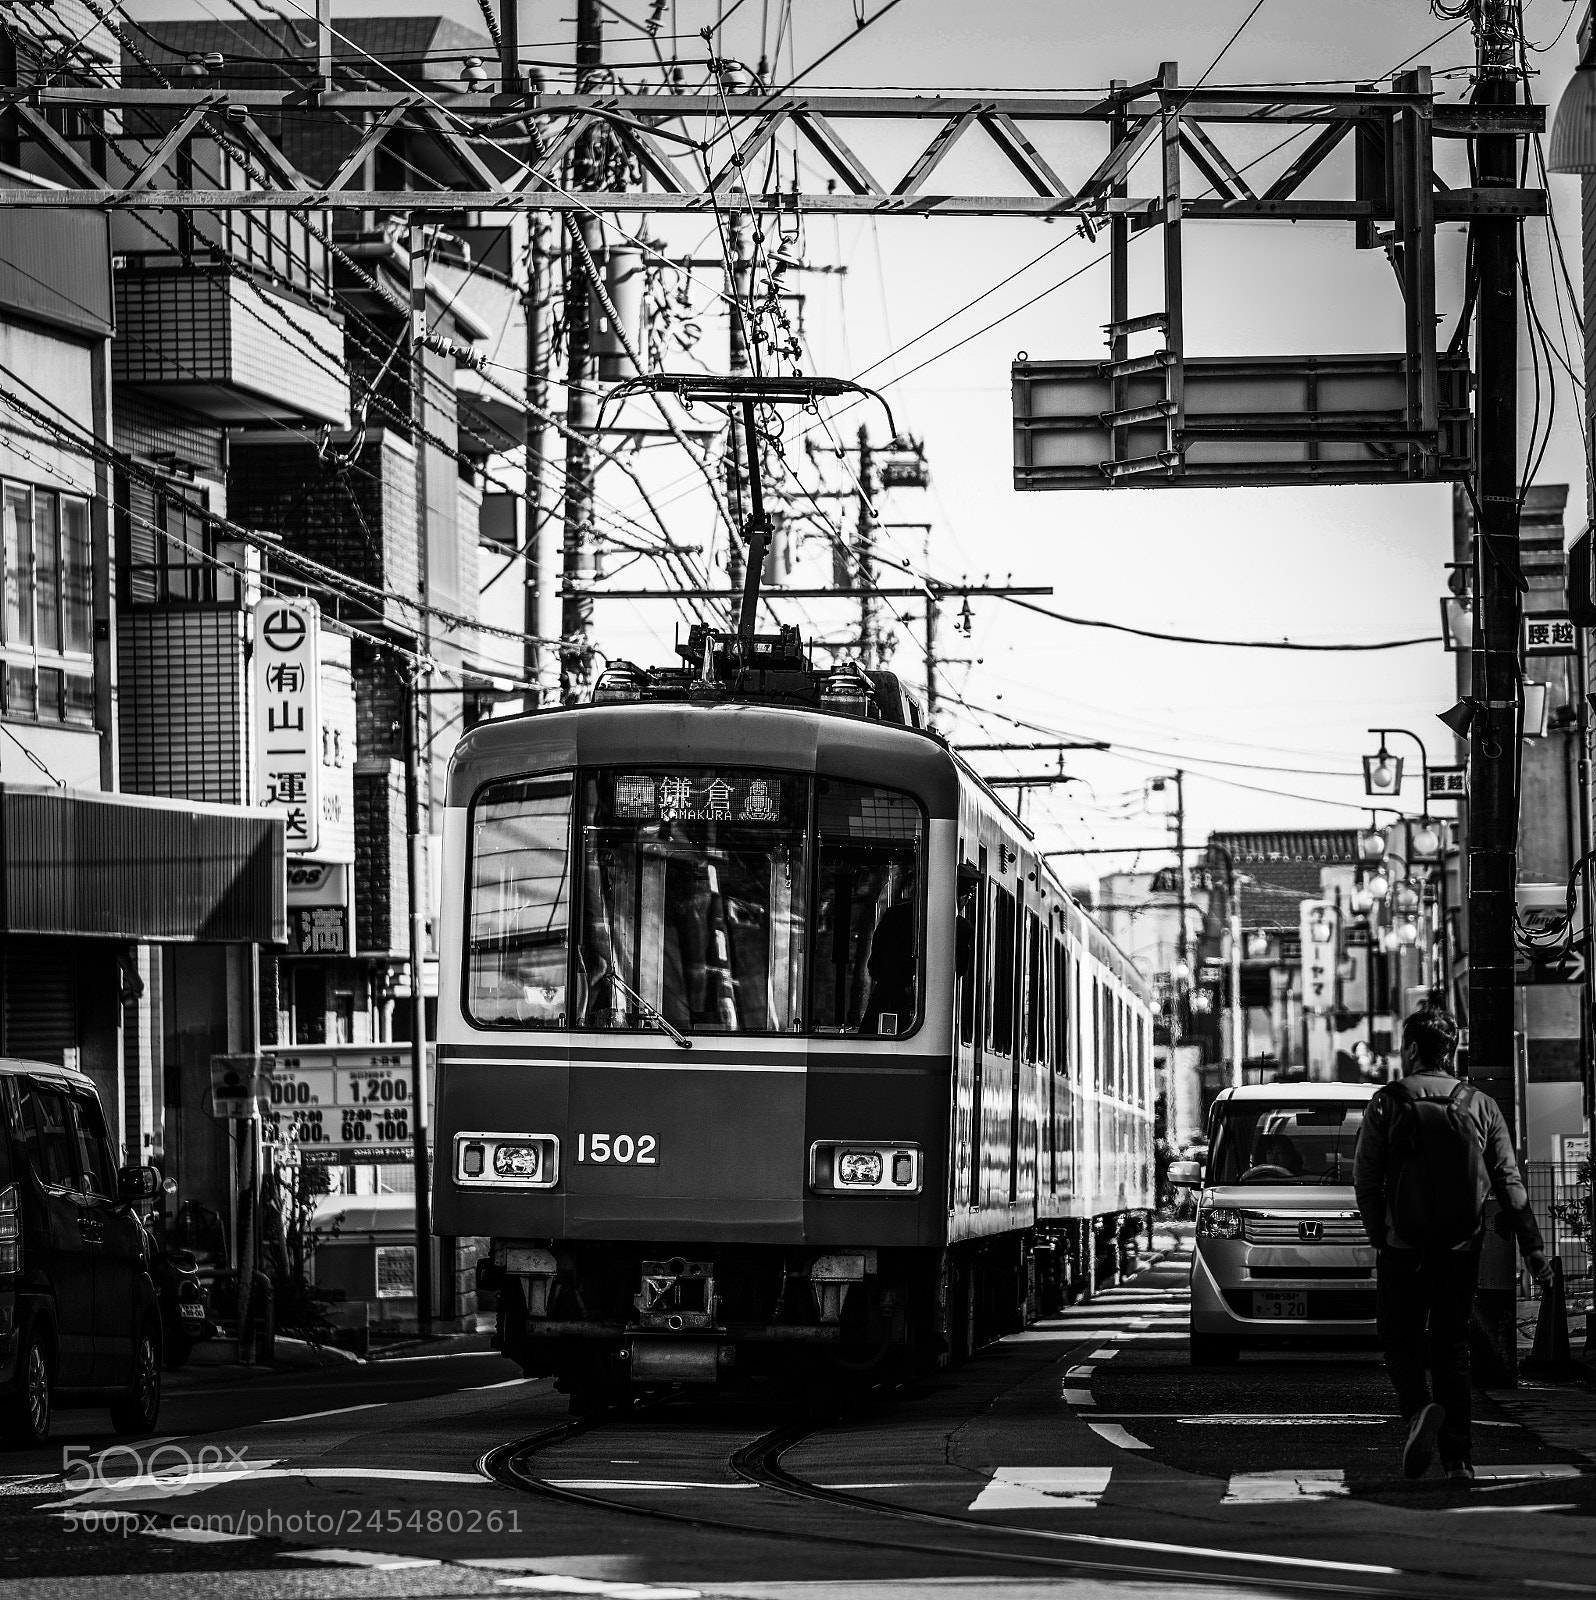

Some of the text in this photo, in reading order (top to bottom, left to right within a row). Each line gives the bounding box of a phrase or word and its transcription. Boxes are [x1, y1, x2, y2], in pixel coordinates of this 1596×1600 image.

[1528, 622, 1574, 645] 腰越
[659, 776, 735, 810] 鎌倉
[660, 809, 732, 821] KAMAKURA
[301, 908, 344, 954] 満
[578, 1133, 656, 1163] 1502
